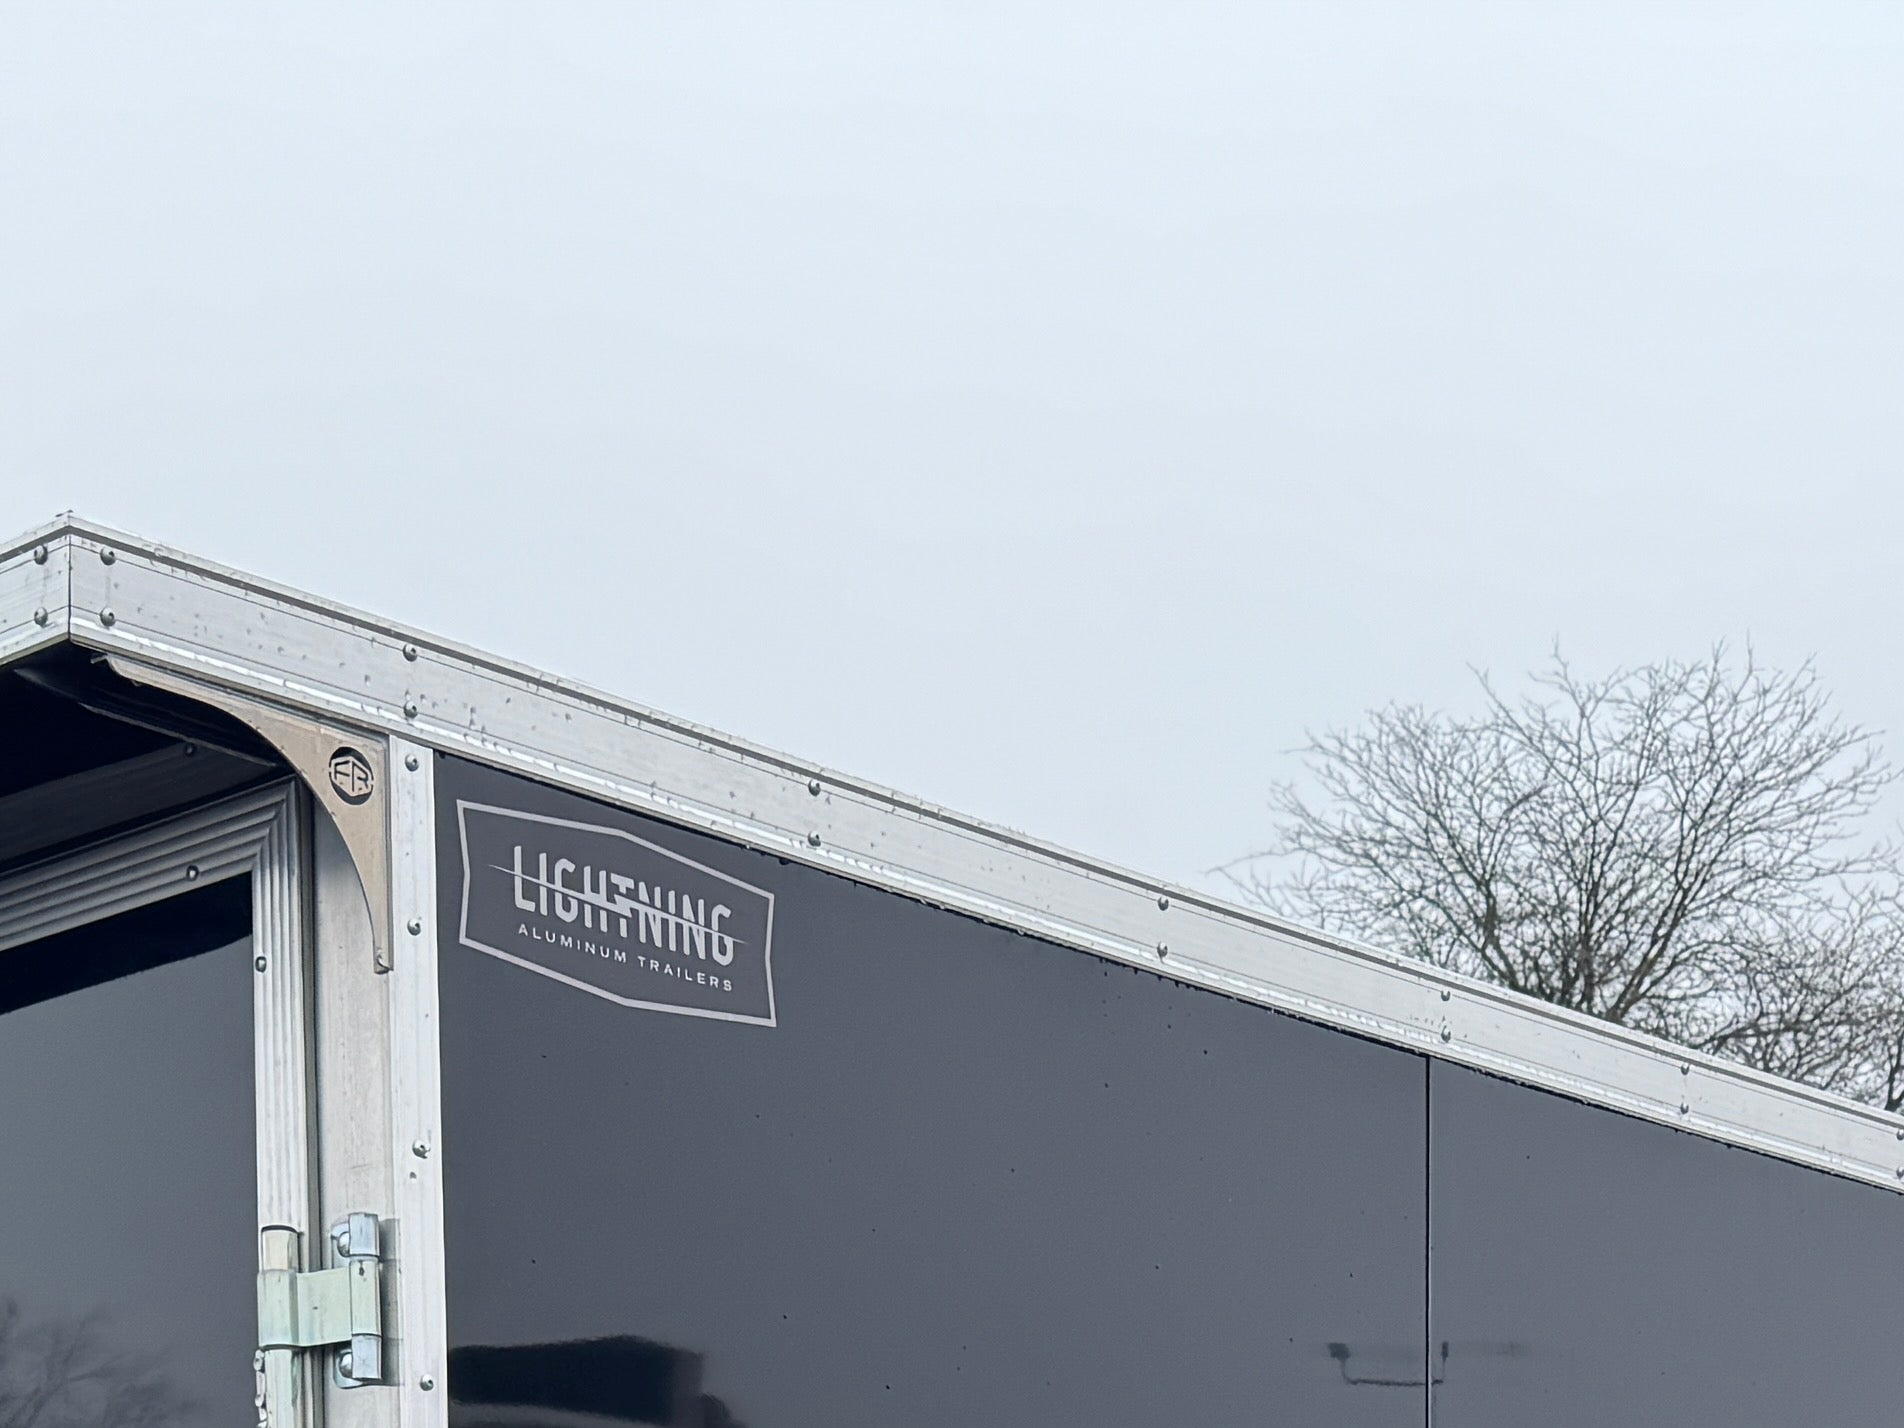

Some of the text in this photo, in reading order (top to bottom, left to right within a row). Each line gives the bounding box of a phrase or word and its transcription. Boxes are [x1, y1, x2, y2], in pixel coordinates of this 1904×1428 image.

[512, 845, 735, 967] LIGHTNING
[518, 923, 734, 993] ALUMINUM TRAILERS
